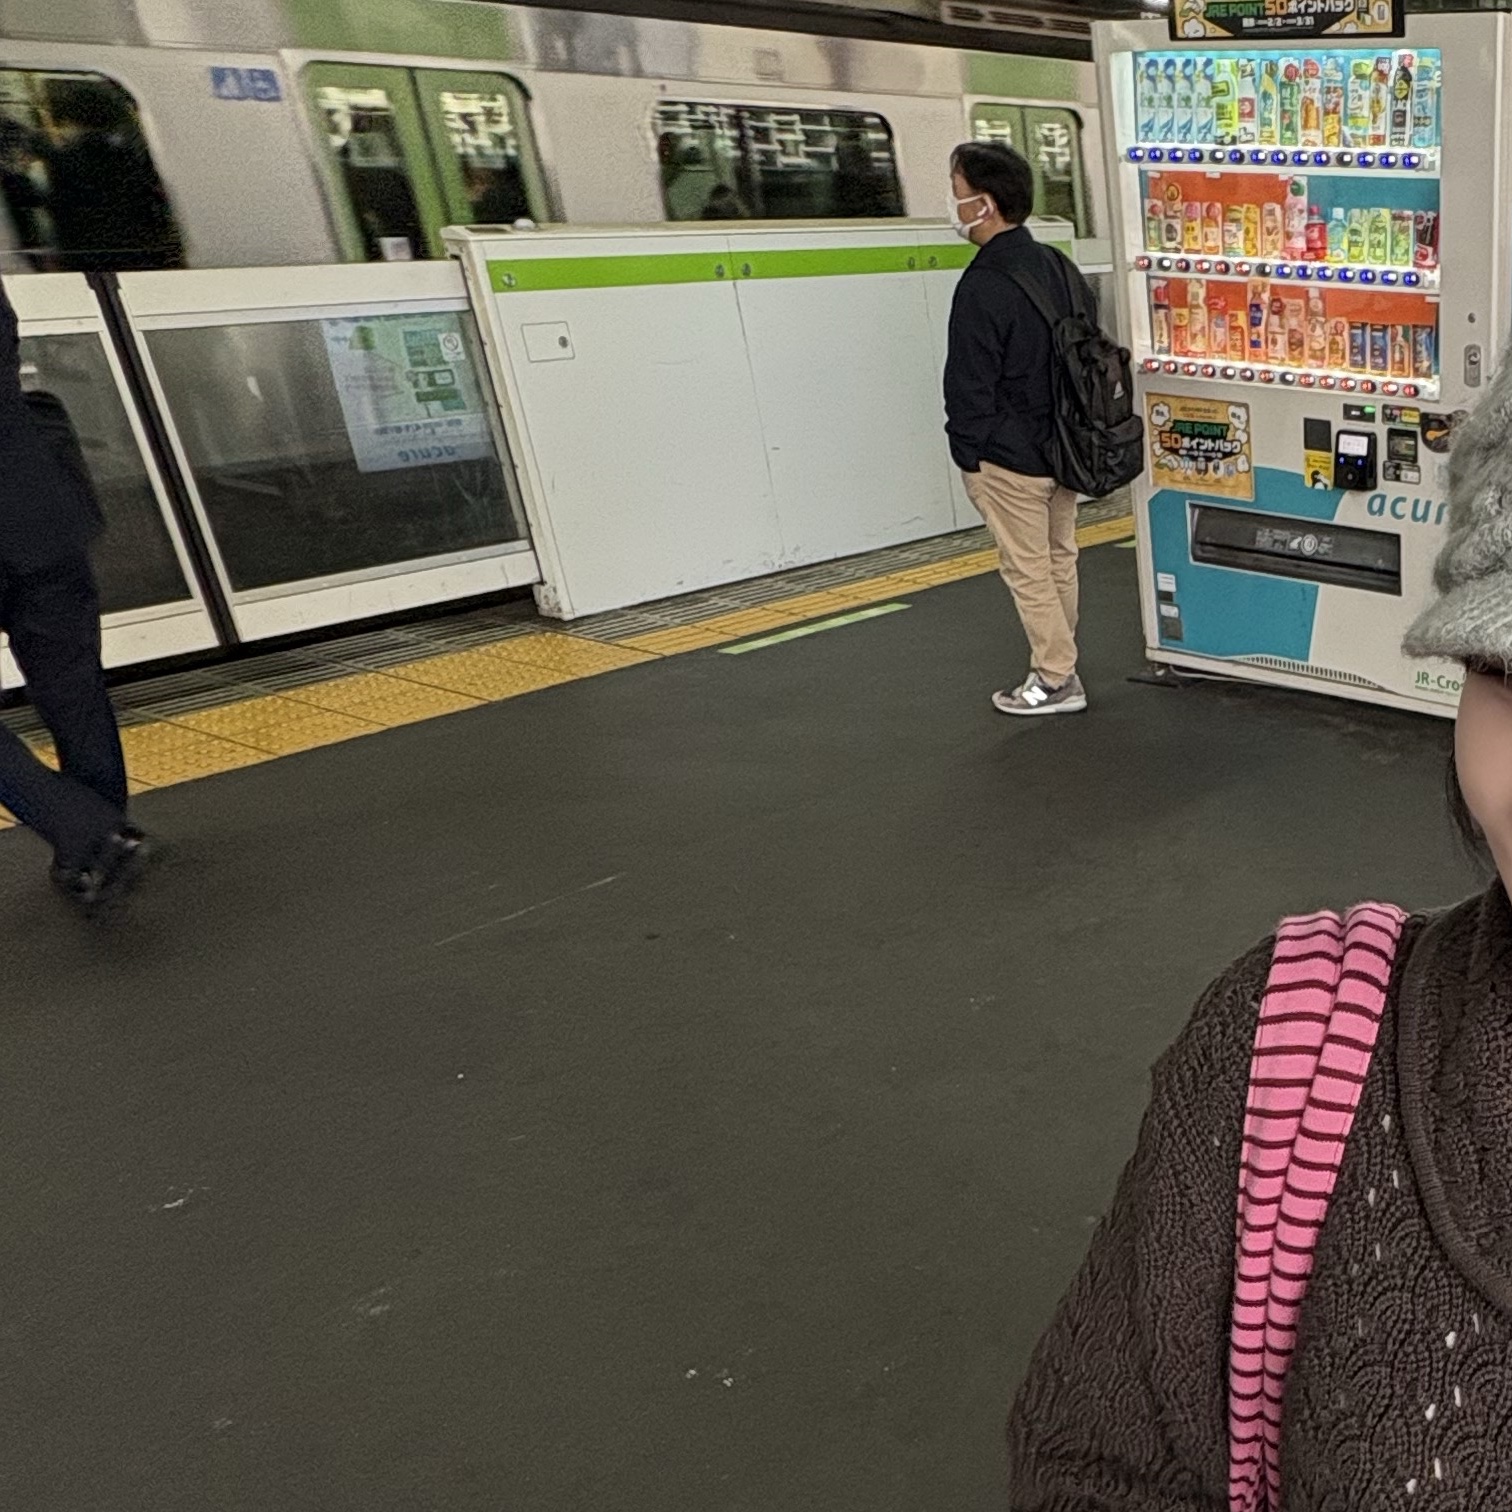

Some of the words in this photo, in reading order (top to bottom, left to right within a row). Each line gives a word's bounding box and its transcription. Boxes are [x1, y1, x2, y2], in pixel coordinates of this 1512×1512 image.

[1205, 4, 1228, 17] JRE
[1229, 3, 1265, 17] POINT
[1194, 423, 1228, 437] POINT
